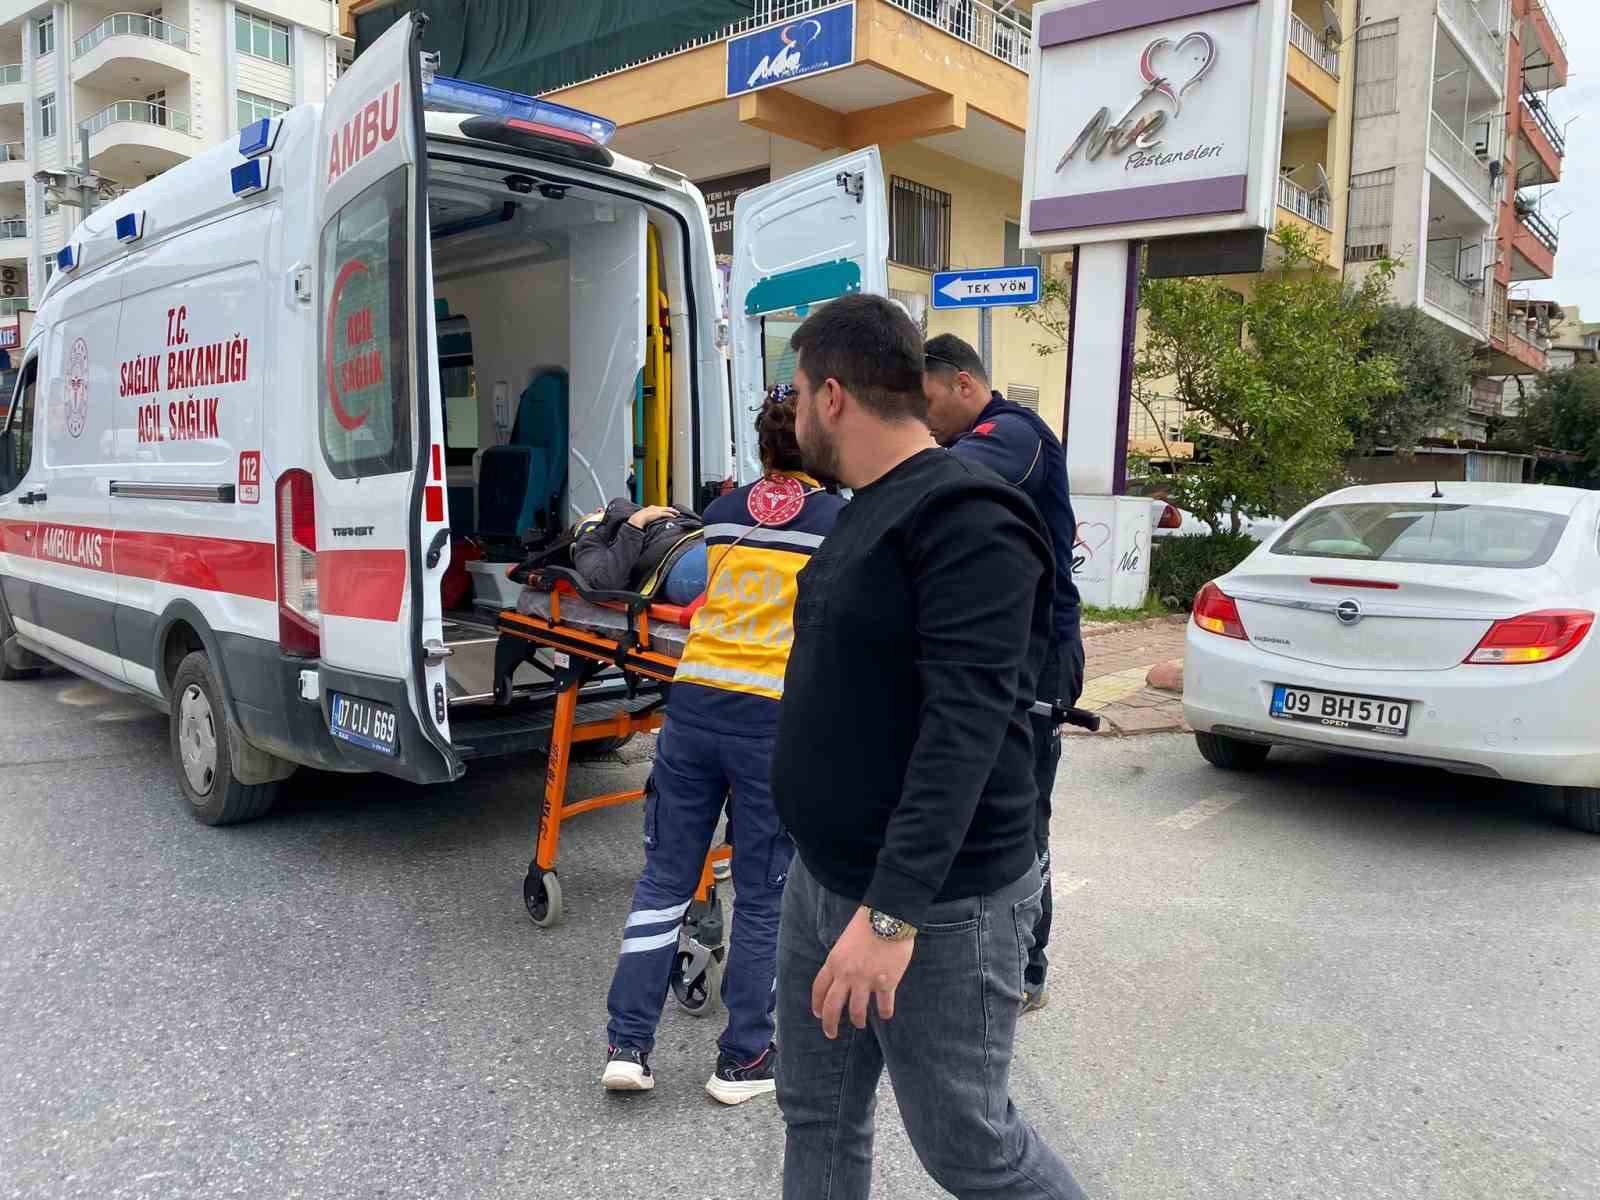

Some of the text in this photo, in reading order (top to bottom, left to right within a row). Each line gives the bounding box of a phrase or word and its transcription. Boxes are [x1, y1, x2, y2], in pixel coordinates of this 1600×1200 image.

[327, 80, 400, 185] AMBU
[1125, 142, 1224, 171] Pastaneleri
[967, 280, 1026, 294] TEK YÖN
[167, 305, 189, 346] T.C.
[120, 354, 161, 398] SAĞLIK
[167, 331, 248, 390] BAKANLIĞI
[138, 393, 219, 443] ACİL SAĞLIK
[243, 456, 257, 481] 112
[43, 527, 103, 568] AMBULANS
[338, 698, 350, 727] 07
[374, 710, 395, 743] 669
[1285, 692, 1310, 713] 09
